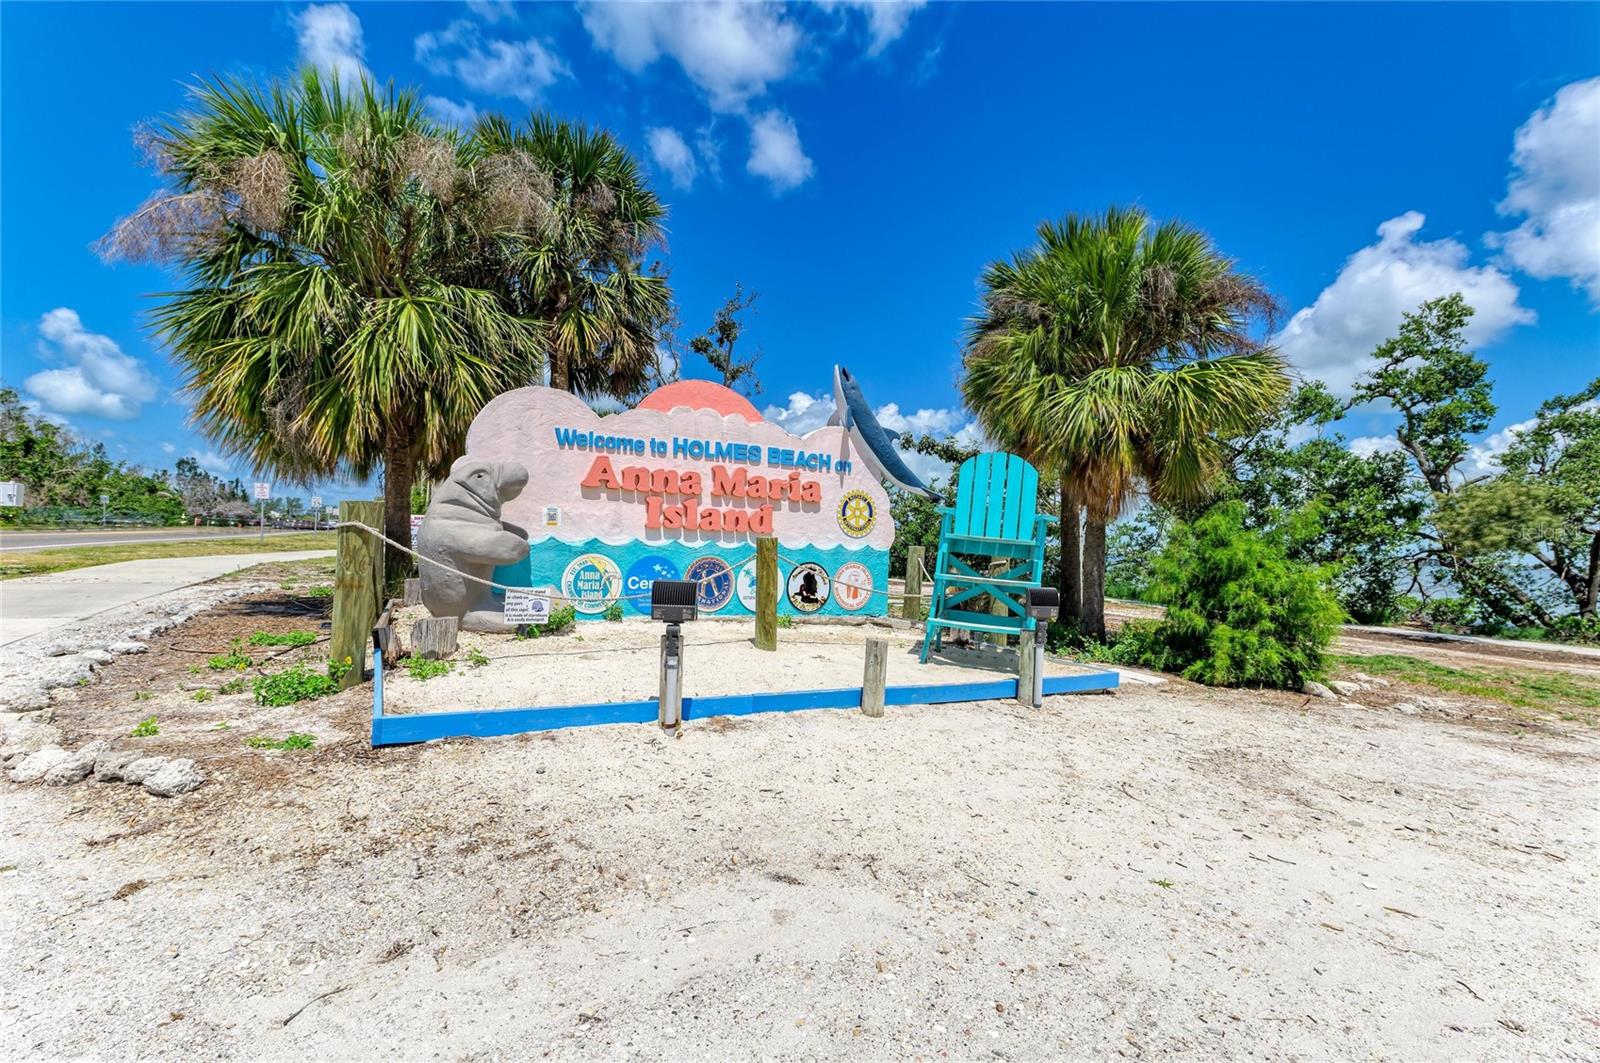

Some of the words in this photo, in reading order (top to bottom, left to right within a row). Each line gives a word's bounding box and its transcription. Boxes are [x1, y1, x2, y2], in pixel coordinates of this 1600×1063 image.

[554, 427, 646, 453] Welcome
[650, 437, 667, 455] to
[673, 437, 762, 462] HOLMES
[767, 447, 832, 471] BEACH
[835, 459, 852, 476] on
[580, 455, 703, 495] Anna
[710, 465, 822, 503] Maria
[645, 495, 774, 534] Island
[577, 580, 600, 590] Maria
[579, 569, 600, 580] Anna
